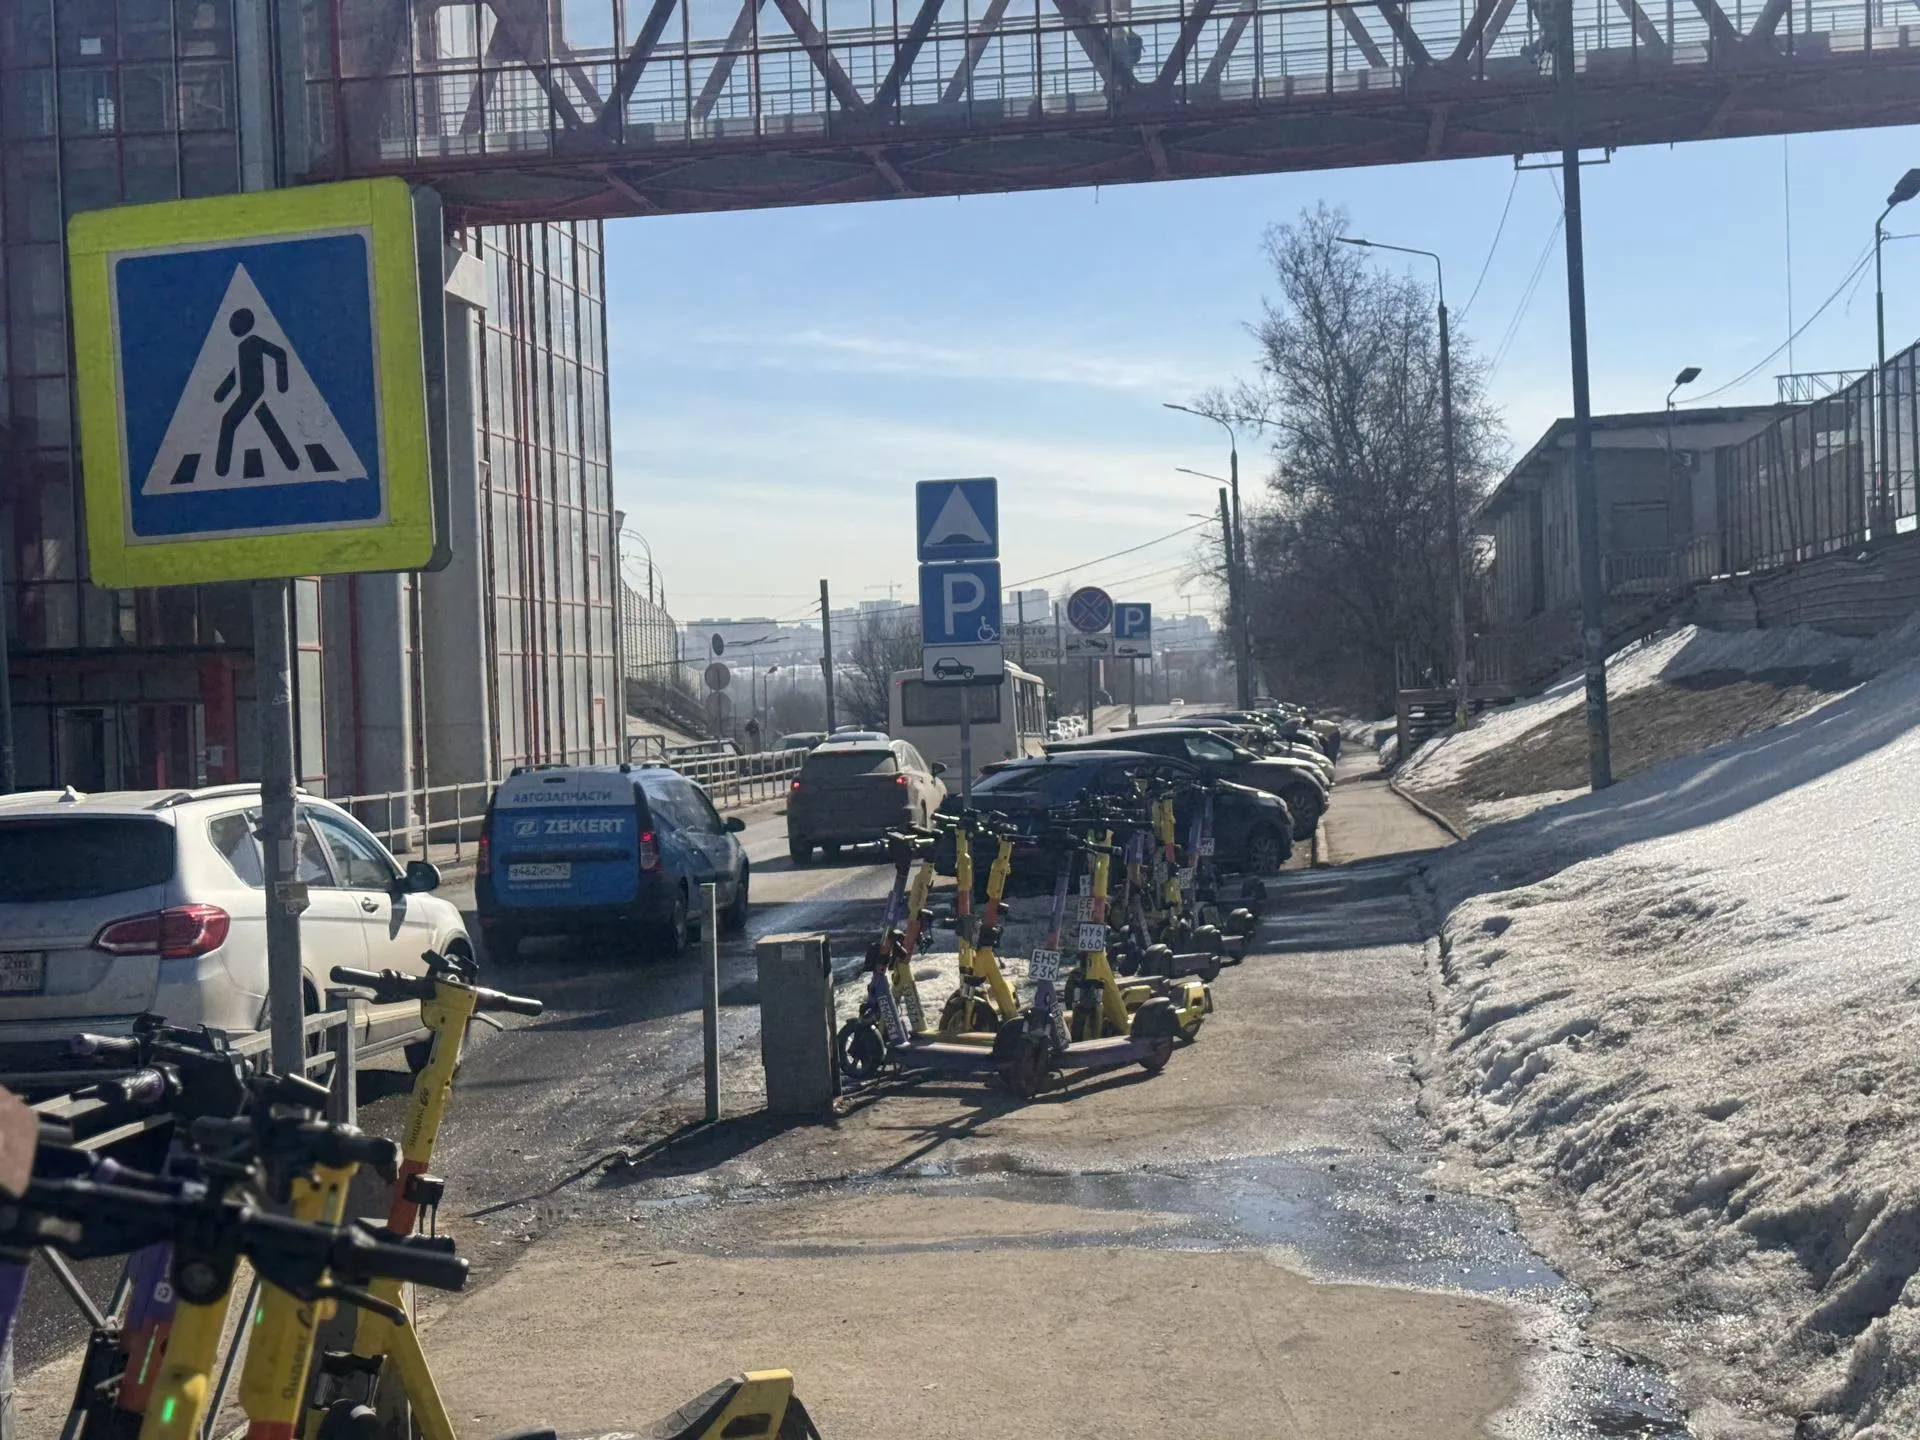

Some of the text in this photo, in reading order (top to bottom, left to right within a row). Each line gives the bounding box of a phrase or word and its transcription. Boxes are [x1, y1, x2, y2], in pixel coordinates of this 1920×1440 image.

[943, 572, 985, 635] P
[1124, 607, 1144, 635] P
[512, 790, 612, 804] АВТОЗАПЧАСТИ
[544, 818, 625, 834] ZEKKERT
[1080, 939, 1103, 949] 660
[1033, 951, 1059, 966] EH5
[1030, 965, 1057, 979] 23K
